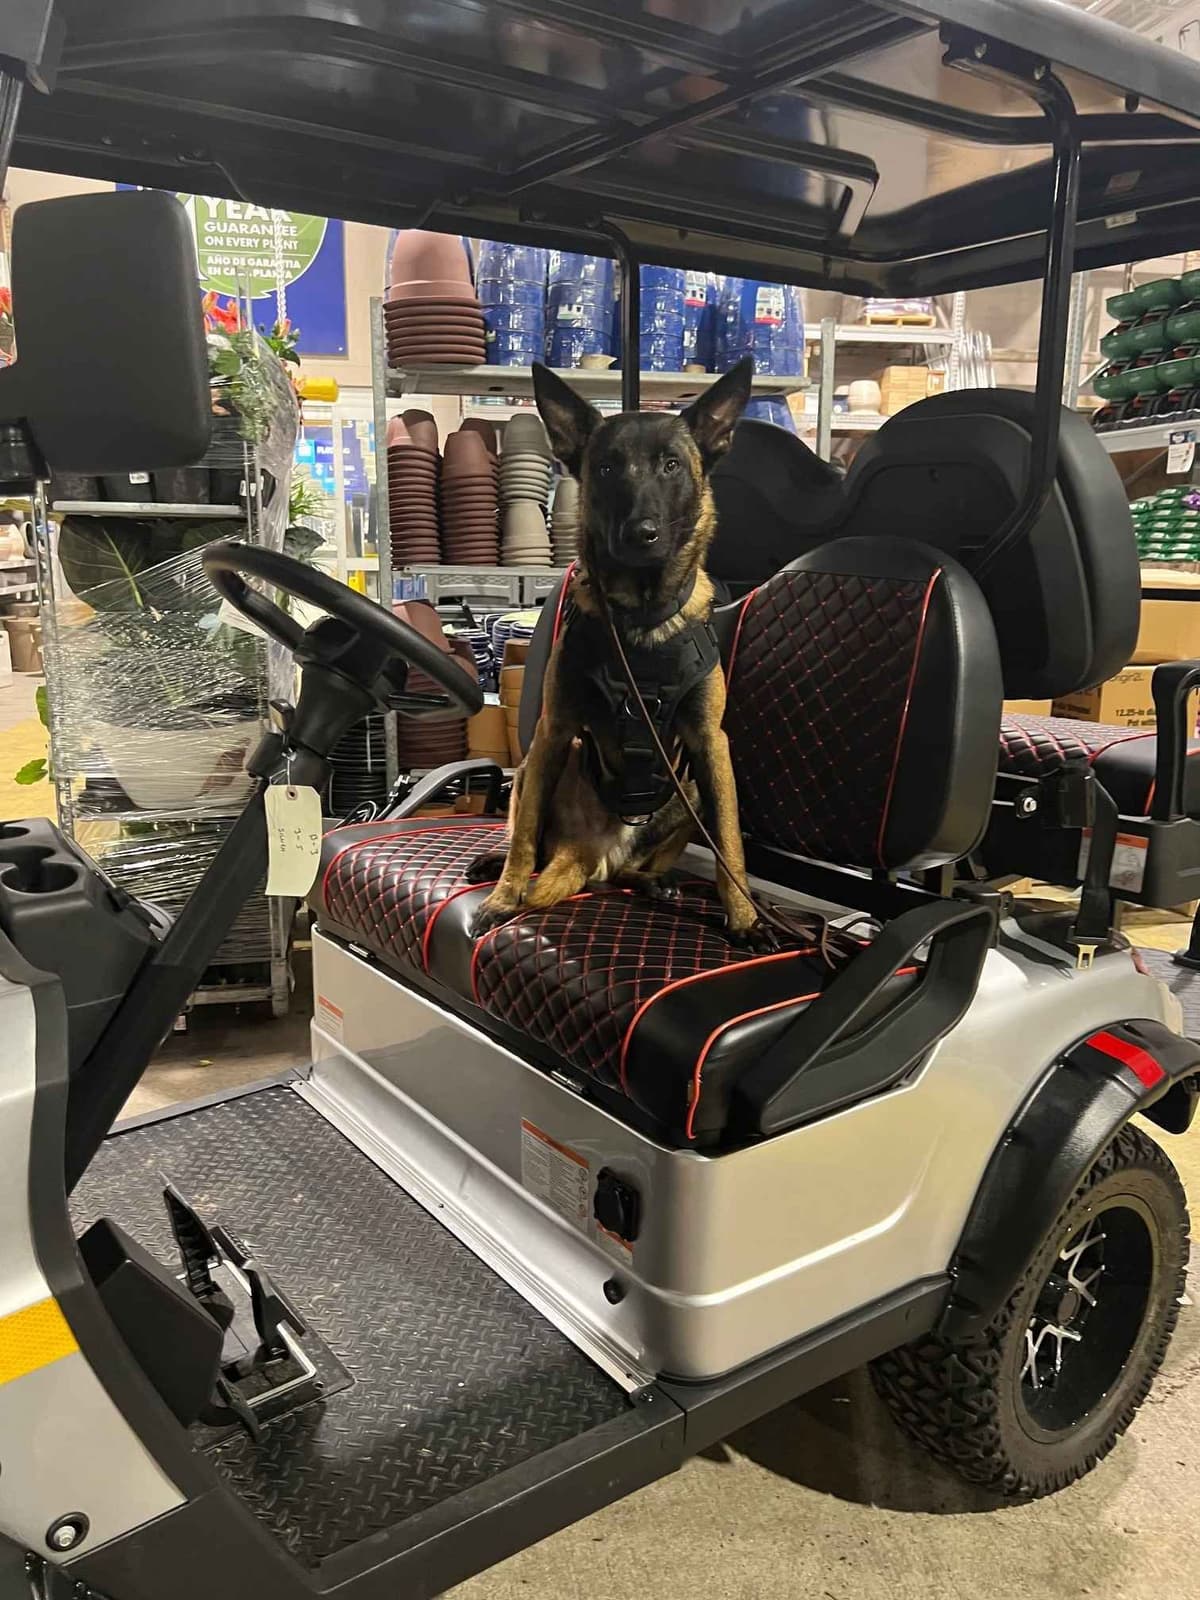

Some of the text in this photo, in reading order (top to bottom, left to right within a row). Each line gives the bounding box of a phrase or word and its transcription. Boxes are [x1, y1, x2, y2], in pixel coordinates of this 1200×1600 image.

[202, 195, 292, 222] YEAR
[205, 235, 224, 246] ON
[226, 237, 260, 249] EVERY
[233, 257, 246, 266] DE
[207, 266, 221, 275] EN
